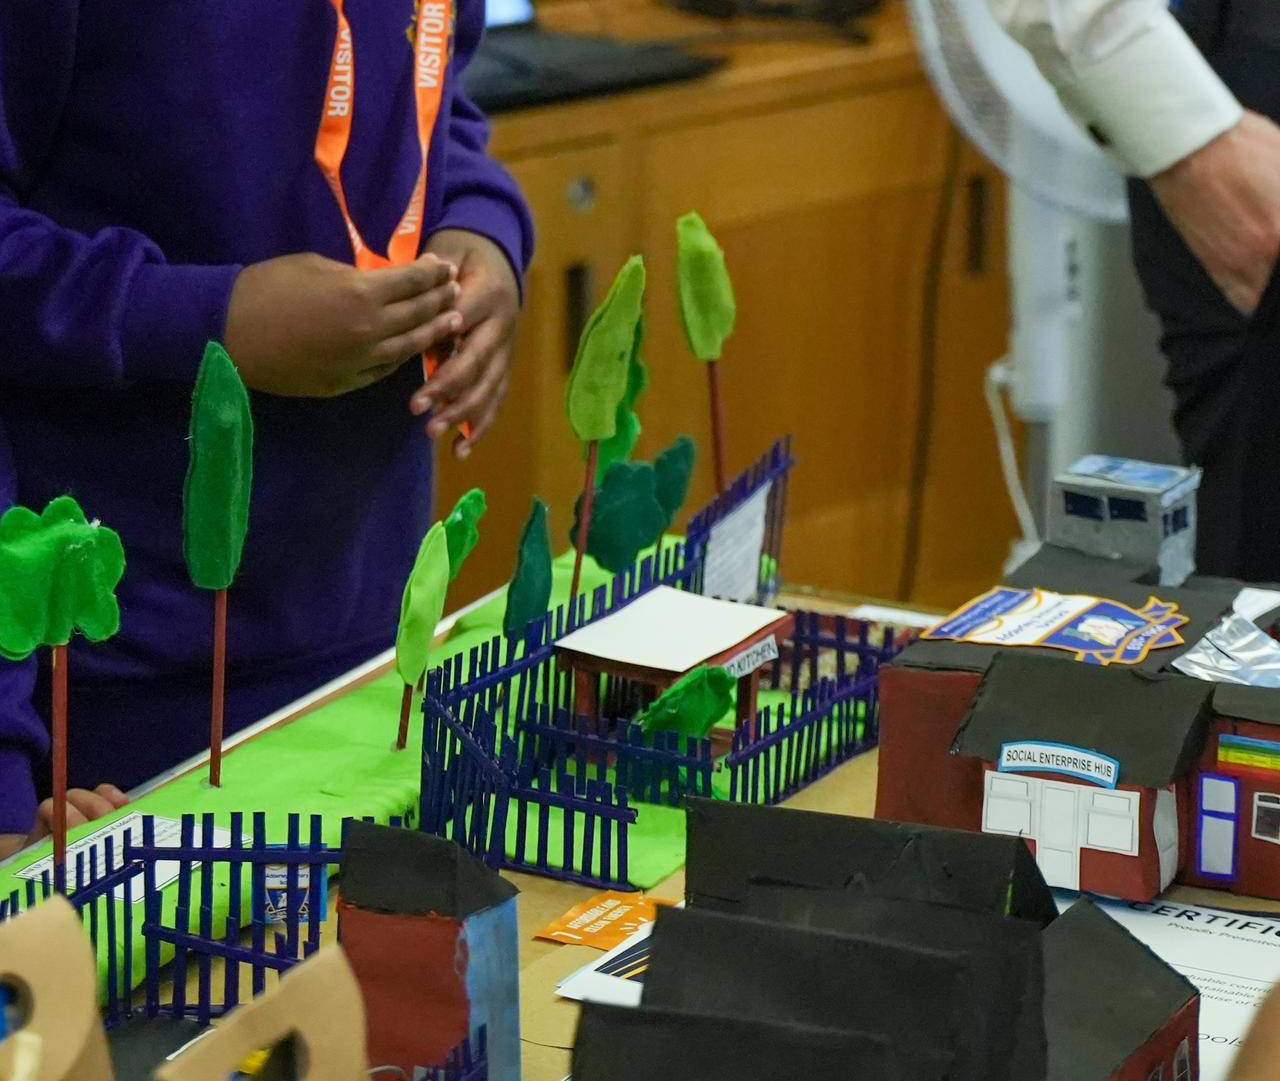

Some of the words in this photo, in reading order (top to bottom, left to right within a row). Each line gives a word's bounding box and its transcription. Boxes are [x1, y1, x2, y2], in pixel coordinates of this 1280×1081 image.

[328, 26, 353, 117] VISITOR
[417, 2, 446, 89] VISITOR
[1006, 749, 1037, 763] SOCIAL
[1039, 752, 1092, 772] ENTERPRISE
[1094, 761, 1112, 777] HUB
[1199, 984, 1255, 999] stainable
